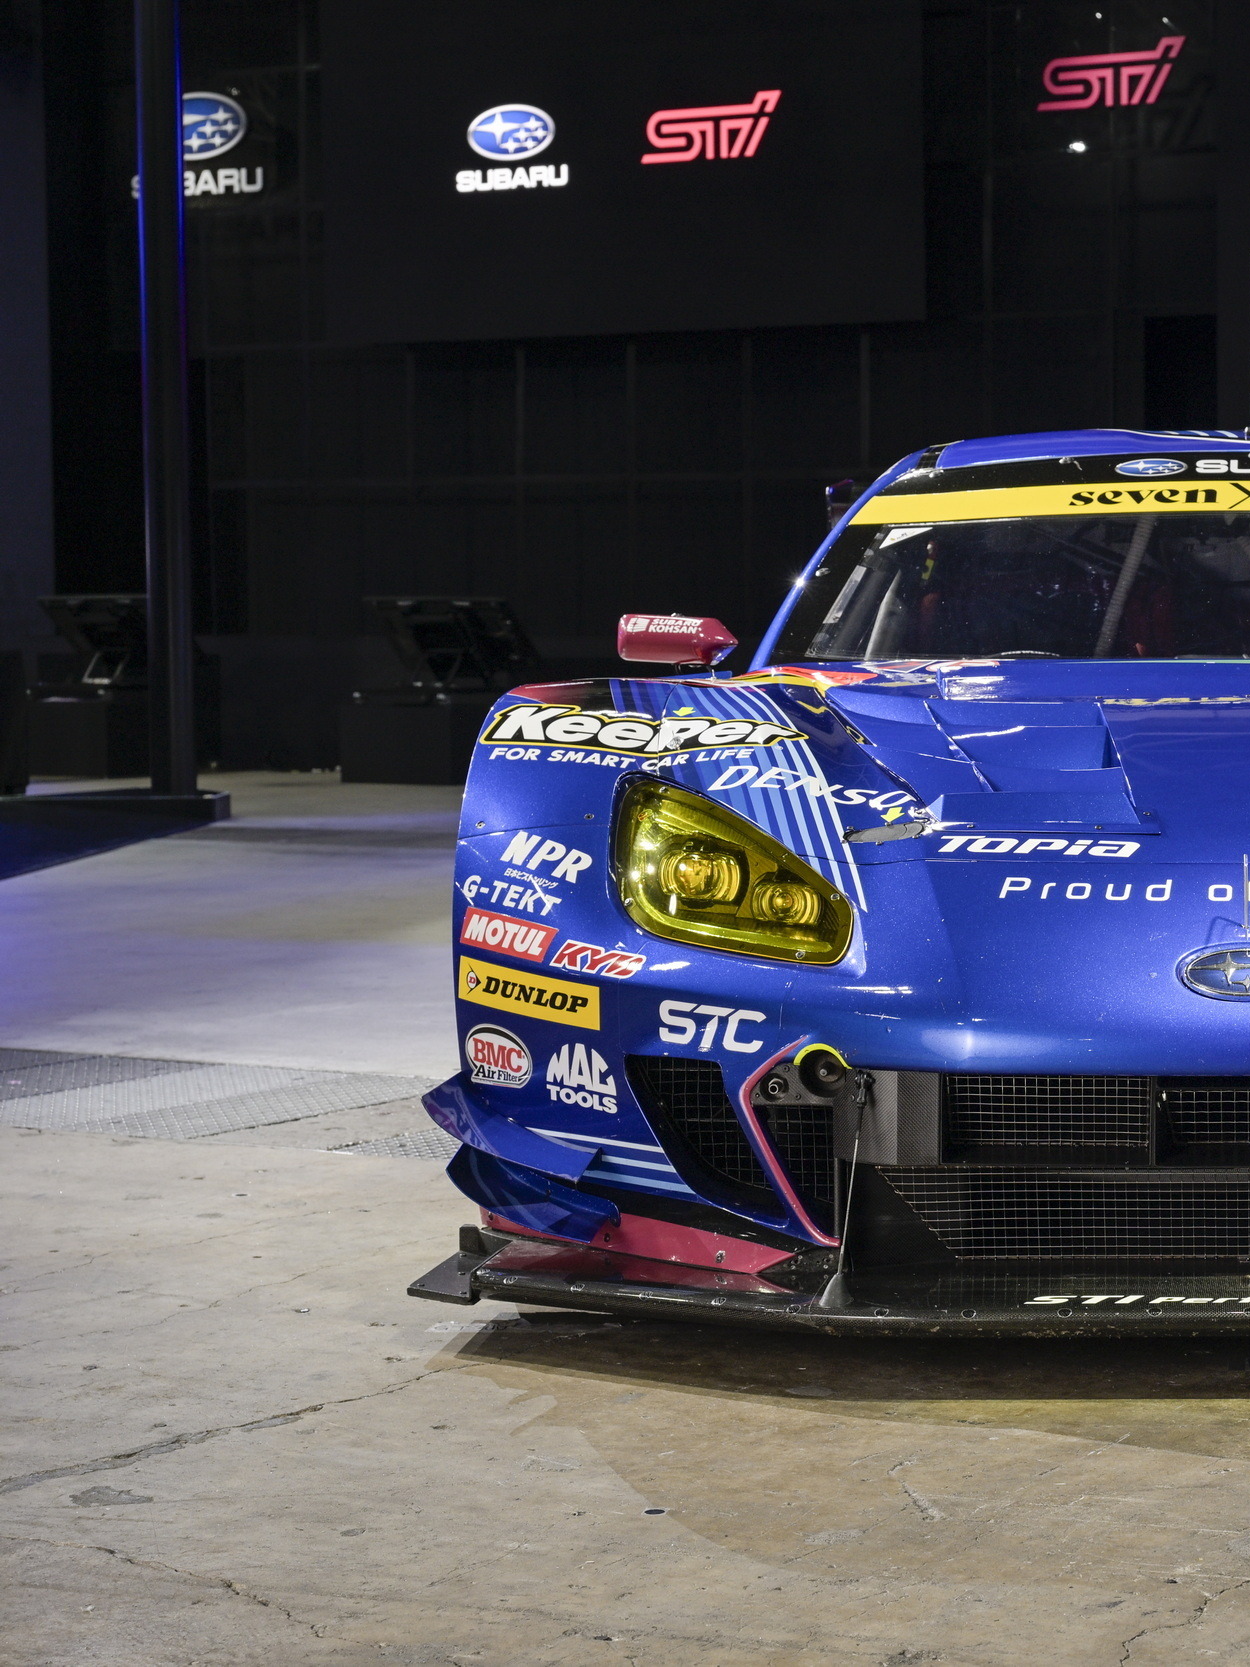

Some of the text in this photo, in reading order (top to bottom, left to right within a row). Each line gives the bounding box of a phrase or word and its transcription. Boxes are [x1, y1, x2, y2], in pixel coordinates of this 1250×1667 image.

[131, 166, 263, 199] BARU
[455, 163, 569, 193] SUBARU
[1068, 488, 1218, 507] seven
[648, 625, 698, 634] KOHSAN
[652, 618, 701, 627] SUBARU
[489, 747, 755, 770] FOR SMART CAR LIFE
[707, 765, 917, 811] DENSO
[500, 829, 593, 884] NPR
[463, 875, 562, 916] G-TEKT
[999, 877, 1173, 901] Proud
[464, 913, 548, 956] MOTUL
[482, 975, 589, 1013] DUNLOP
[658, 1000, 767, 1053] STC
[472, 1037, 523, 1073] BMC
[546, 1043, 617, 1096] MAC
[474, 1064, 496, 1079] Air
[497, 1069, 520, 1082] Filter
[546, 1084, 618, 1114] TOOLS
[1025, 1295, 1145, 1304] STI
